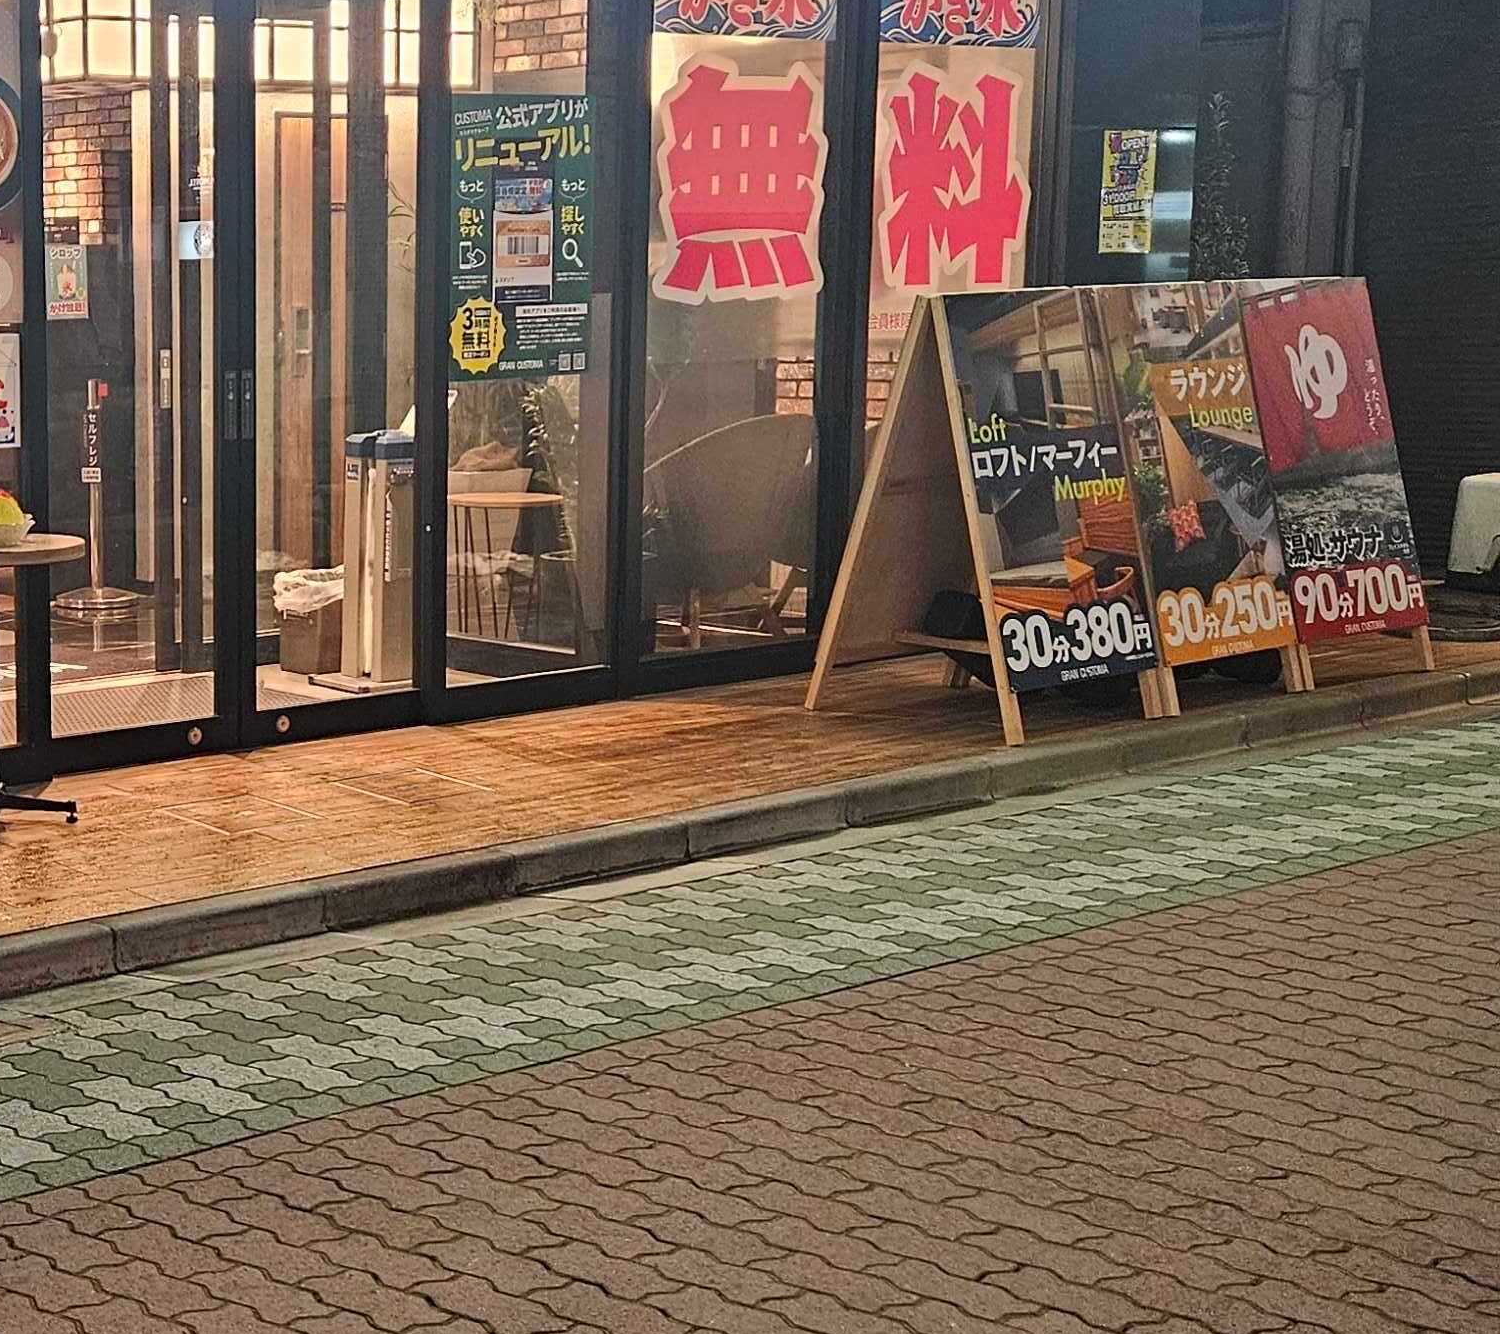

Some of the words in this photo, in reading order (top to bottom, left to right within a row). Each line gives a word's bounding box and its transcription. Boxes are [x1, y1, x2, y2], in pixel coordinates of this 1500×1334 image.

[454, 109, 493, 125] CUSTOMA
[495, 97, 589, 130] 公式アプリが
[455, 123, 591, 171] リニューアル!
[460, 179, 484, 192] もっと
[561, 178, 586, 192] もっと
[459, 224, 484, 238] やすく
[561, 222, 585, 236] やすく
[499, 361, 516, 371] GRAN
[516, 359, 544, 370] CUSTOMA
[1284, 323, 1348, 421] ゆ
[1170, 363, 1246, 401] ラウンジ
[968, 412, 1007, 444] Loft
[1188, 402, 1254, 429] Lounge
[88, 413, 98, 466] セルフレジ
[971, 439, 1118, 479] ロフト/マーフィー
[1054, 467, 1126, 505] Murphy
